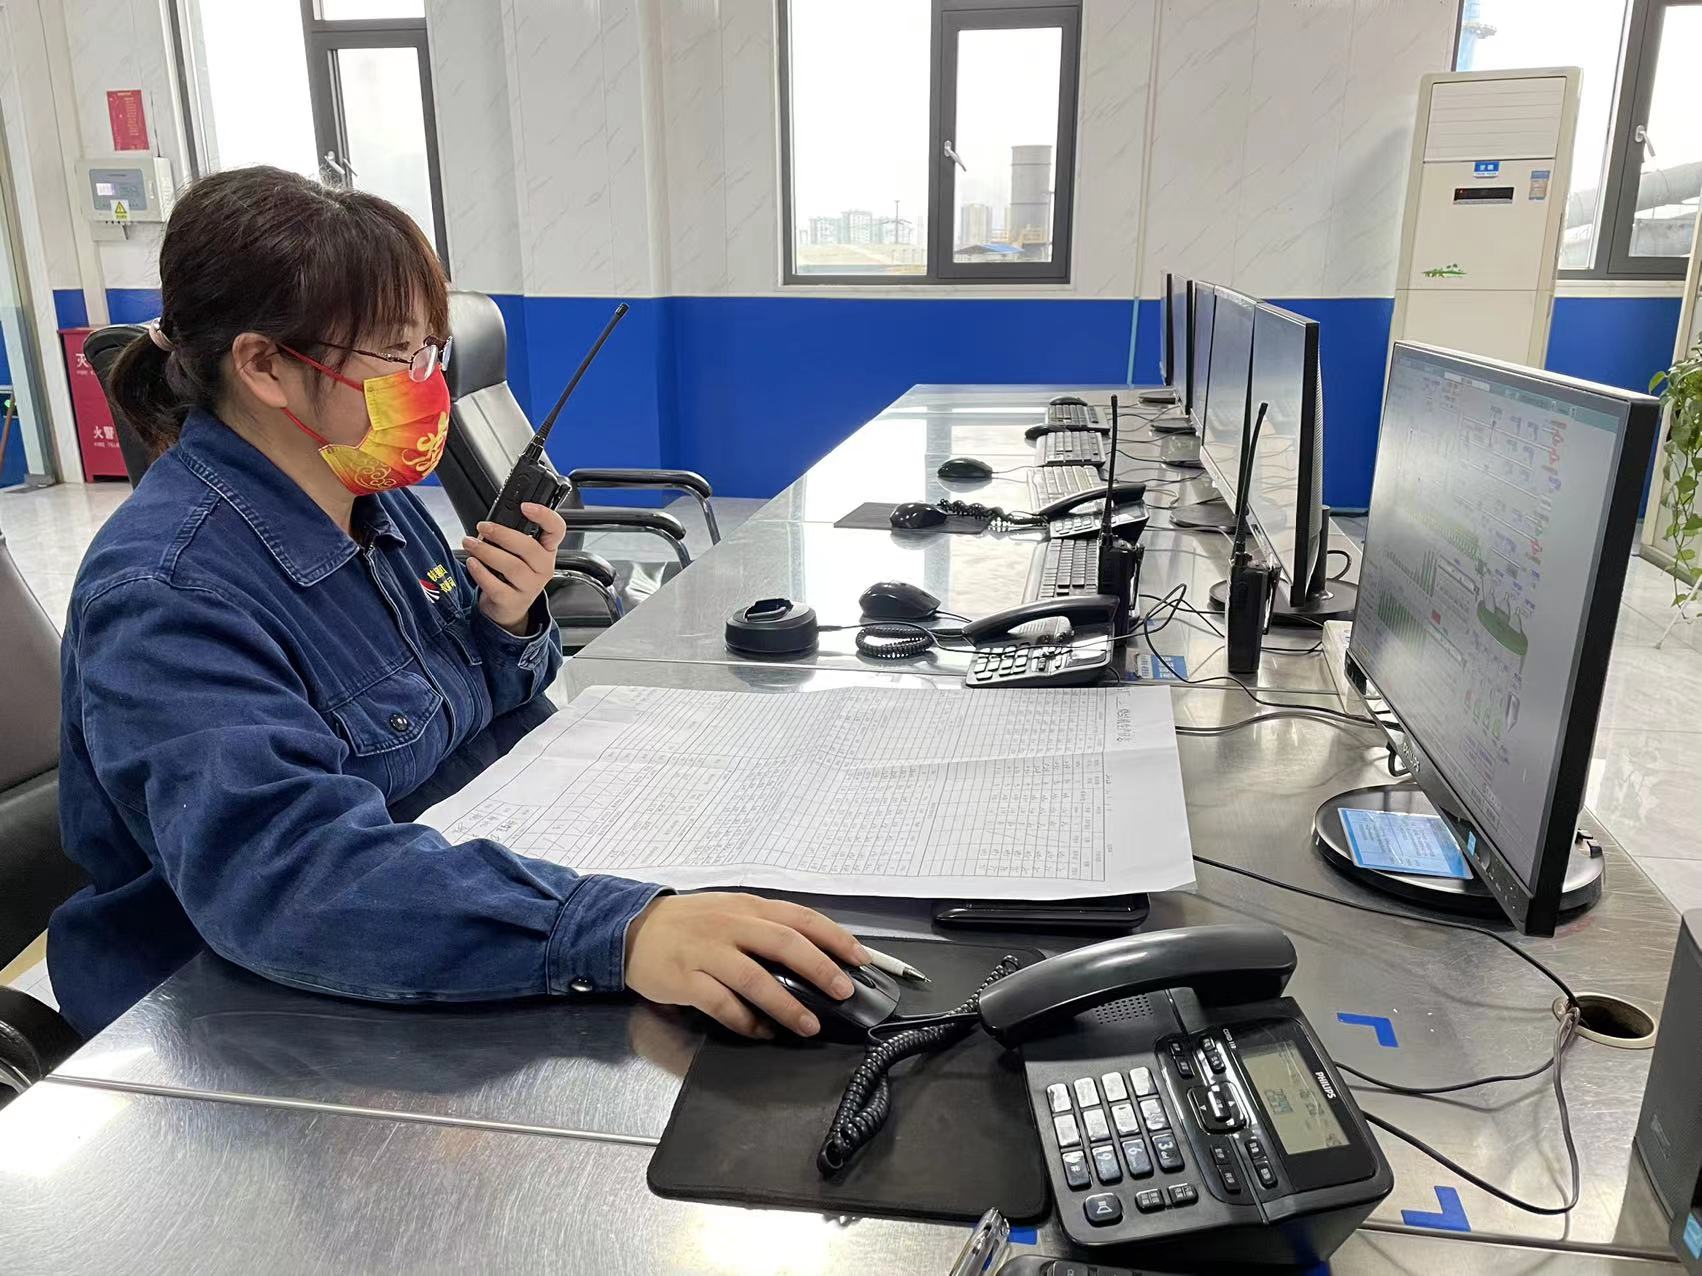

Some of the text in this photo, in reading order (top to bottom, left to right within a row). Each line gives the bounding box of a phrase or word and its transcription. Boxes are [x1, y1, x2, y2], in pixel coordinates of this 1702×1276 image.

[1315, 1071, 1337, 1099] PHILIPS
[1158, 1141, 1174, 1150] 3
[1127, 1147, 1143, 1155] 6
[1097, 1152, 1112, 1160] 9
